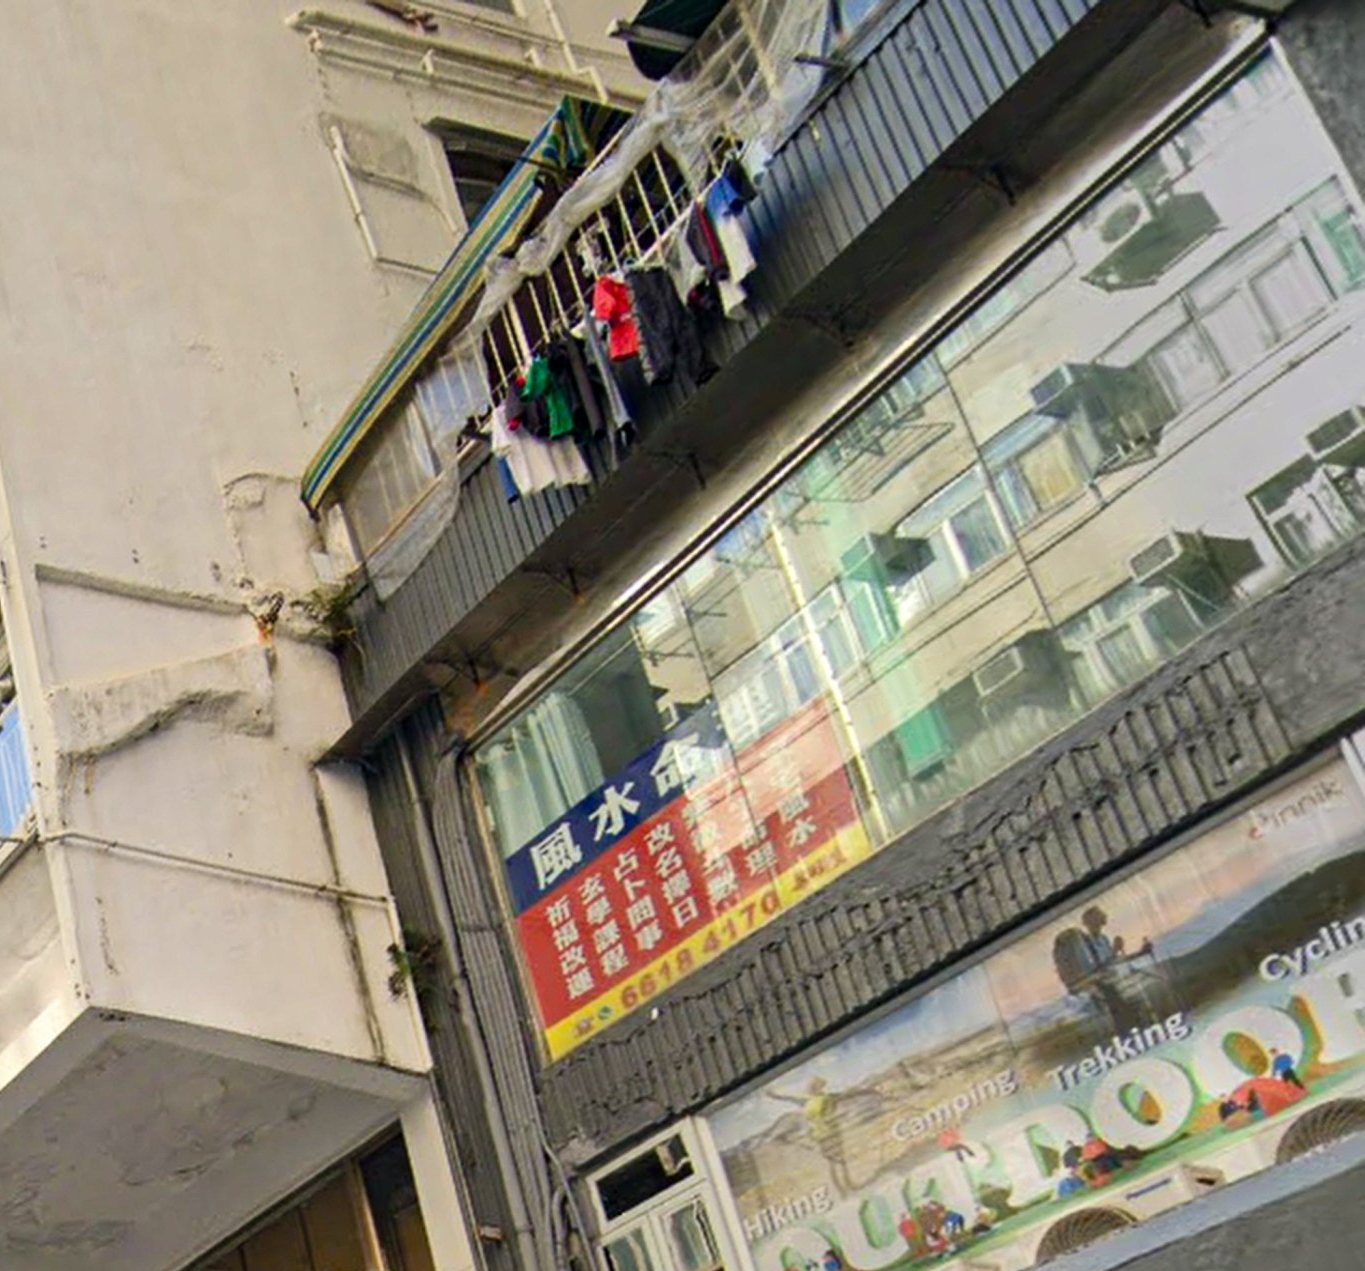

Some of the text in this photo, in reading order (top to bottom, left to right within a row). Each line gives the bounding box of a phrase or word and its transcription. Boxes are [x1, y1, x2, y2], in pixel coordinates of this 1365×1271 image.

[613, 850, 663, 950] 占卜問事
[1047, 1012, 1192, 1091] Trekking
[890, 1069, 1020, 1145] Camping
[742, 1185, 833, 1242] Hiking
